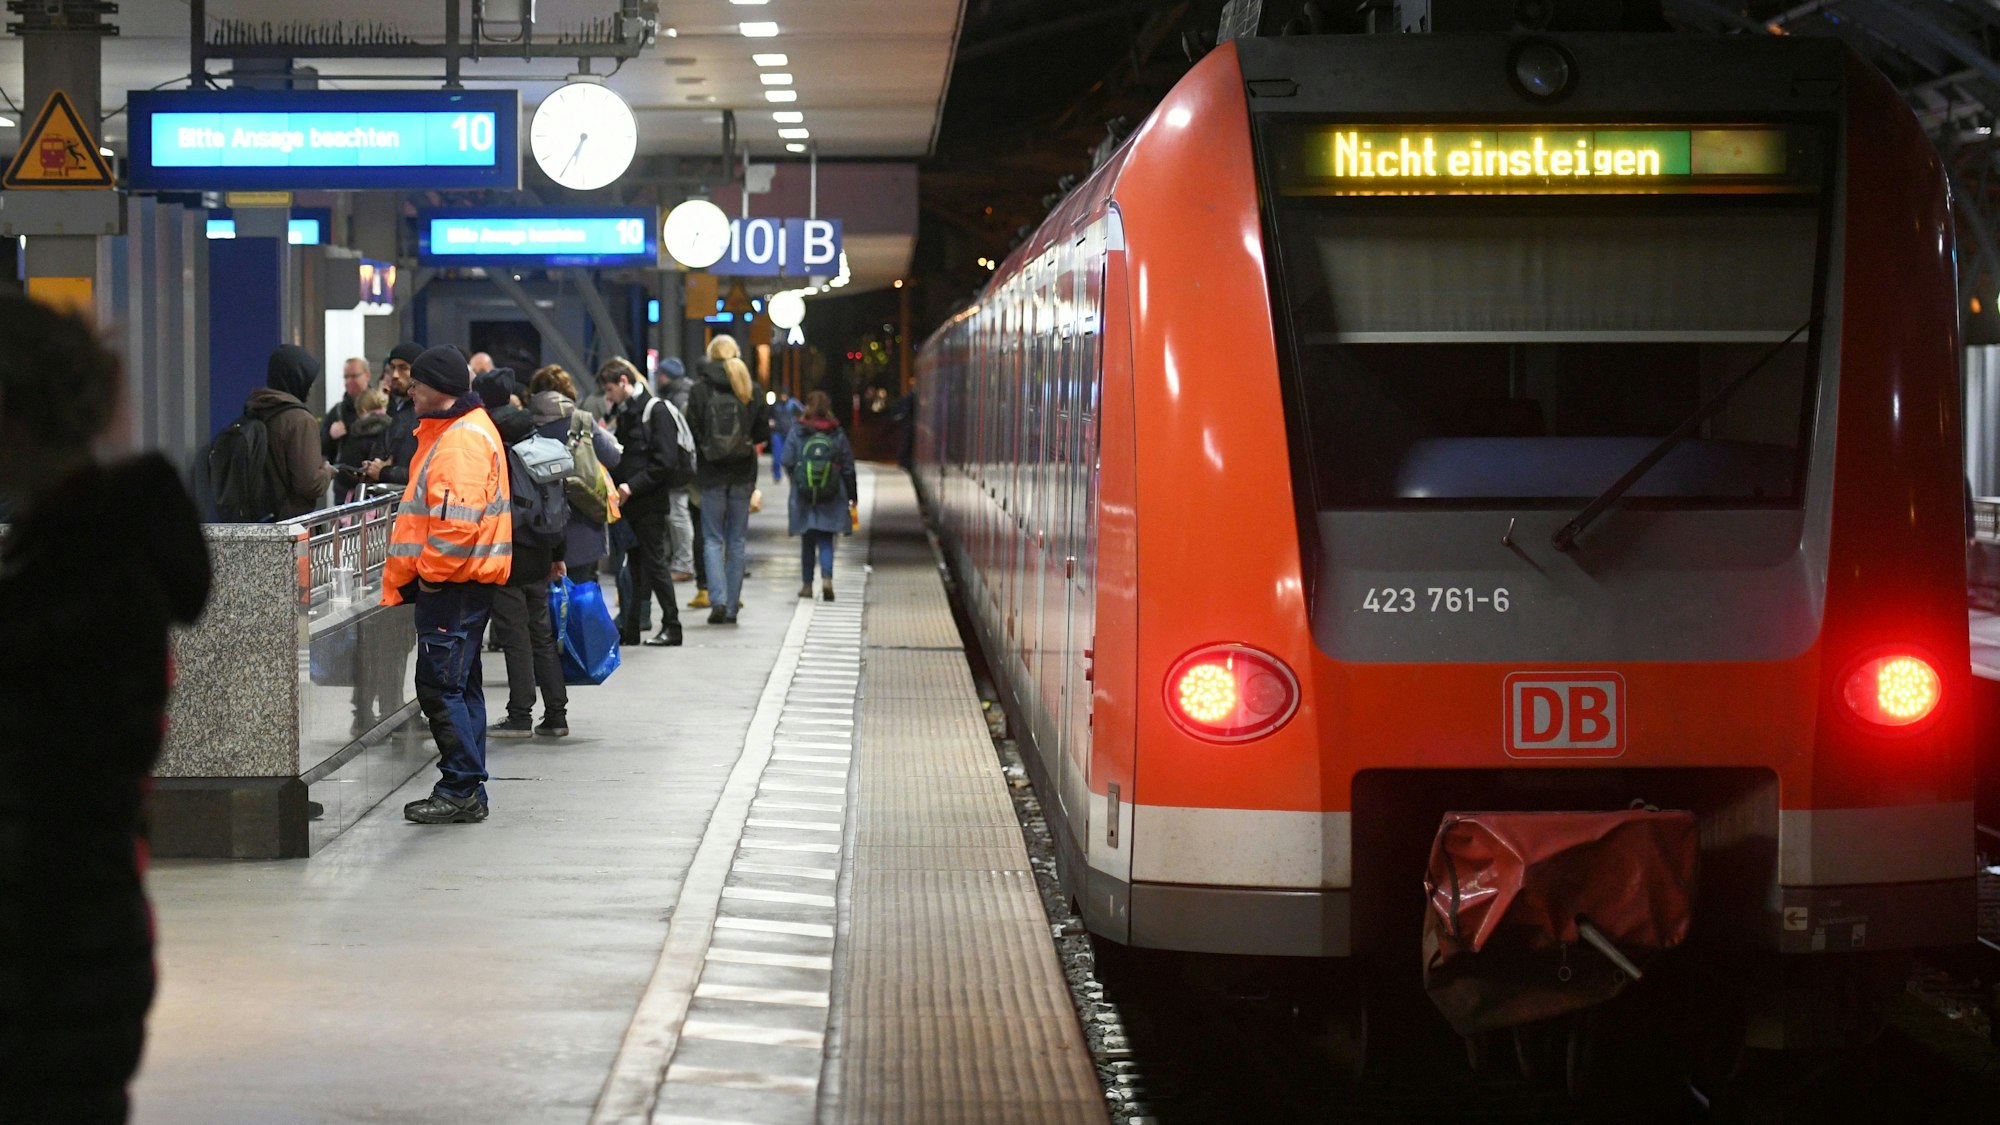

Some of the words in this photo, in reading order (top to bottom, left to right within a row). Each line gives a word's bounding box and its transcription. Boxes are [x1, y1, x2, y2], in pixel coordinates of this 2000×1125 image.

[178, 128, 224, 148] Bitte
[231, 128, 304, 153] Ansage
[310, 128, 399, 148] beachten
[450, 113, 493, 151] 10
[1334, 131, 1436, 177] Nicht
[1447, 136, 1661, 177] einsteigen
[616, 219, 644, 245] 10
[803, 219, 836, 264] B
[1362, 587, 1416, 613] 423
[1427, 587, 1510, 613] 761-6
[1520, 686, 1611, 743] DB
